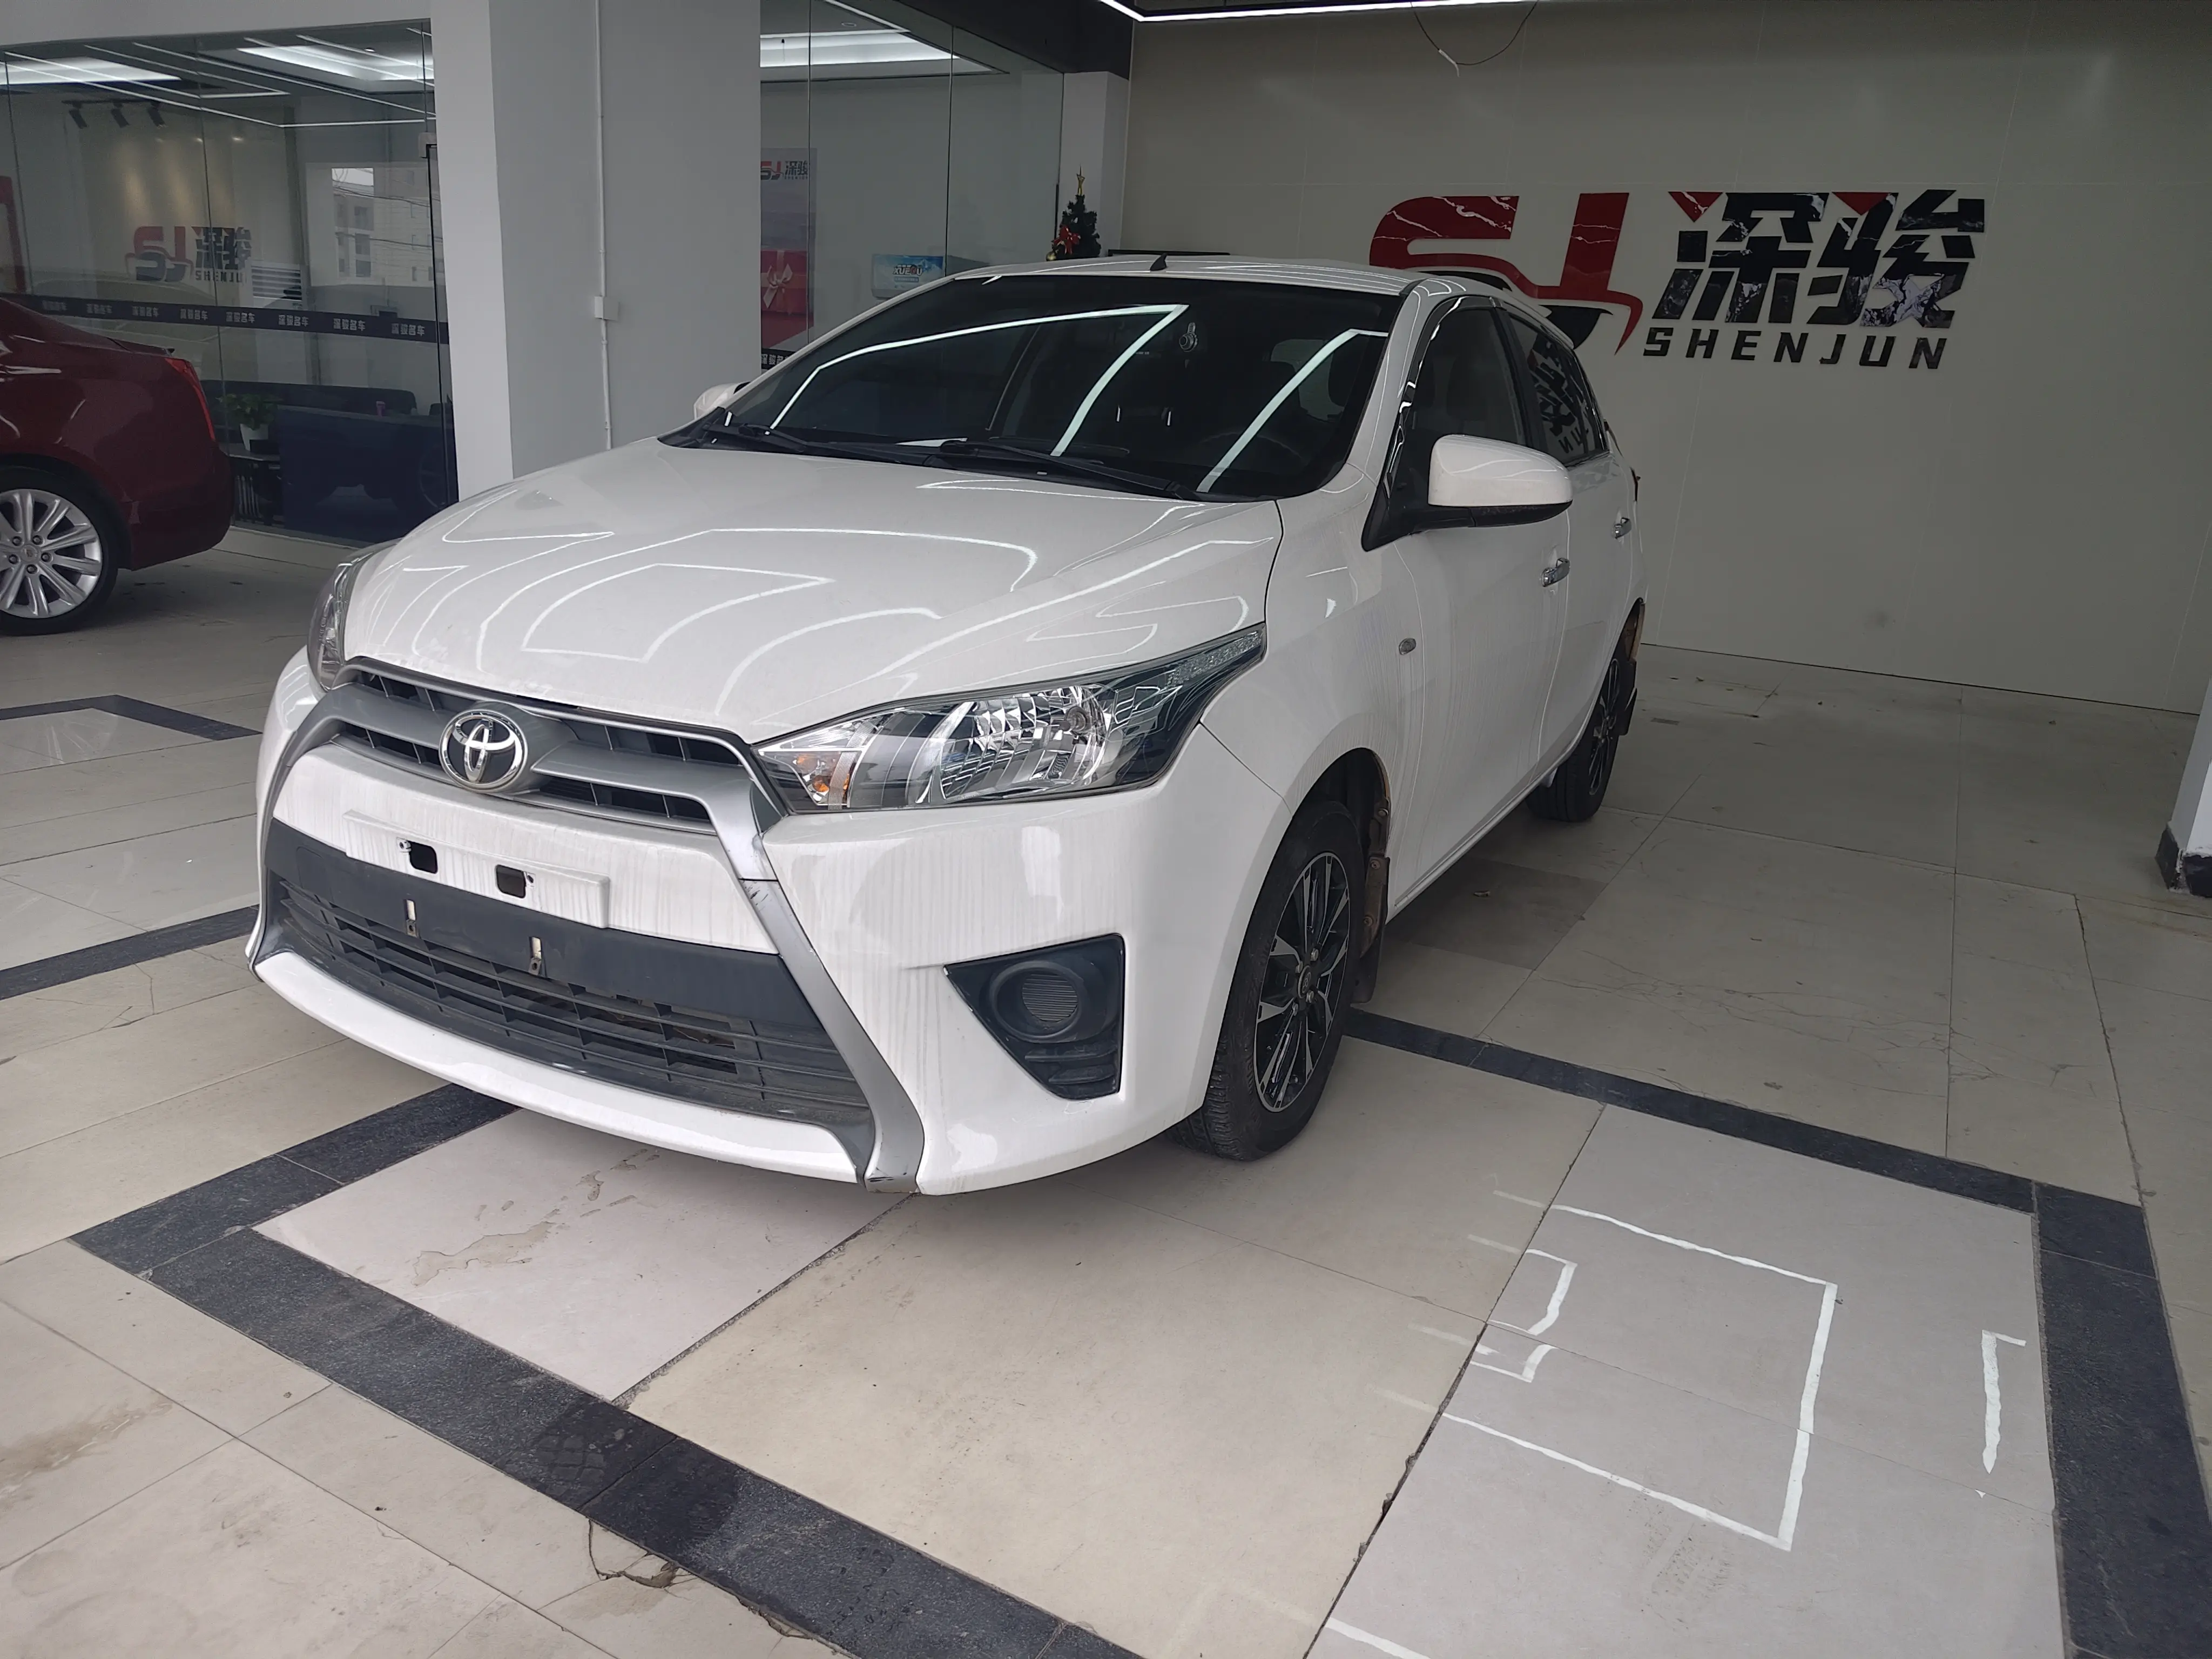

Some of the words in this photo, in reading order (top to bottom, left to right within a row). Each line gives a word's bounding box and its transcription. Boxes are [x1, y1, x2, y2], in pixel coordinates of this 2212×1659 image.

[1652, 189, 1985, 328] 深骏
[195, 270, 247, 284] SHENJU
[333, 318, 366, 332] 深骏名车
[391, 323, 425, 337] 深骏名车
[1643, 327, 1947, 369] SHENJUN
[761, 354, 789, 365] 深骏名
